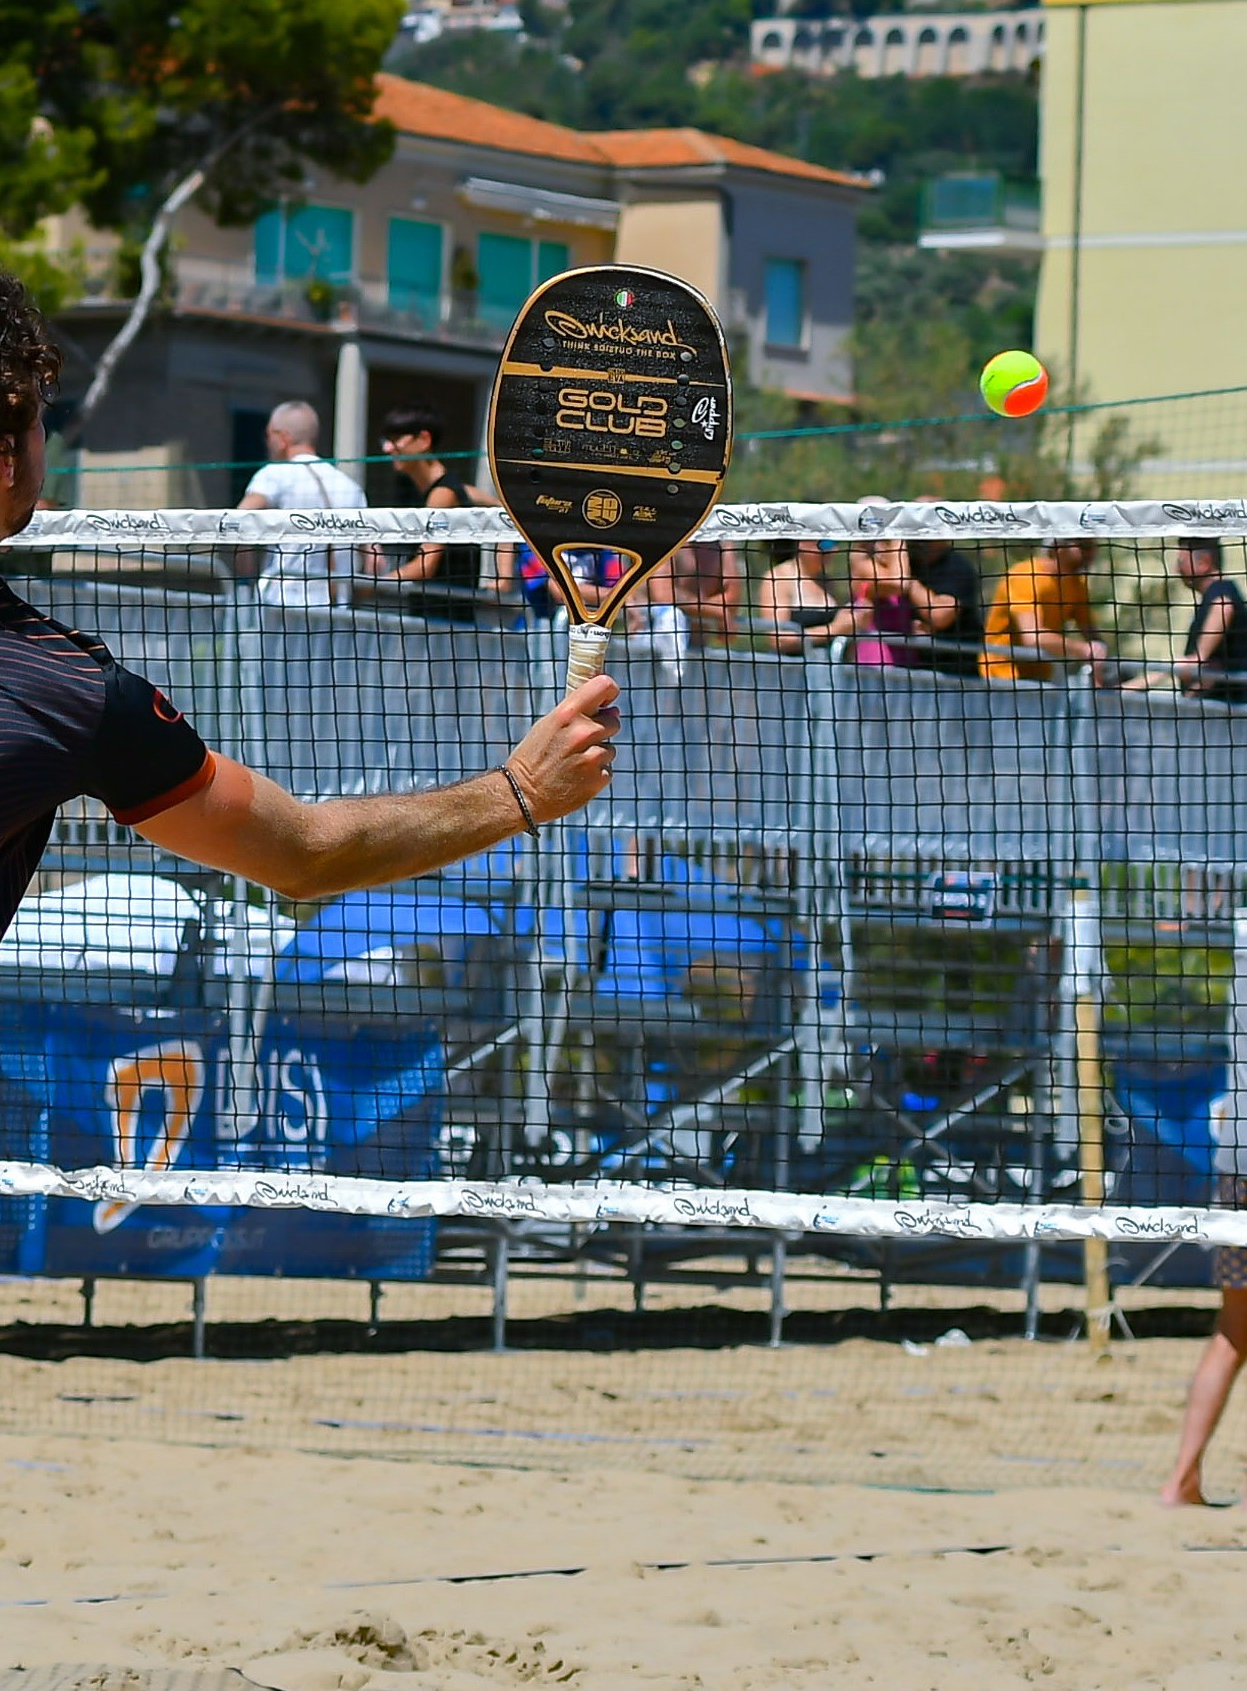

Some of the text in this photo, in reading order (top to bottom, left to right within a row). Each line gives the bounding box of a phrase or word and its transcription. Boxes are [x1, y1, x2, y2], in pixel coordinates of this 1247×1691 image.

[544, 310, 697, 356] Quicksand
[562, 340, 591, 350] THINK
[558, 388, 668, 416] GOLD
[556, 409, 666, 437] CLUB
[289, 511, 379, 533] Quicksand
[715, 505, 805, 529] Quicksand
[935, 505, 1031, 529] Quicksand
